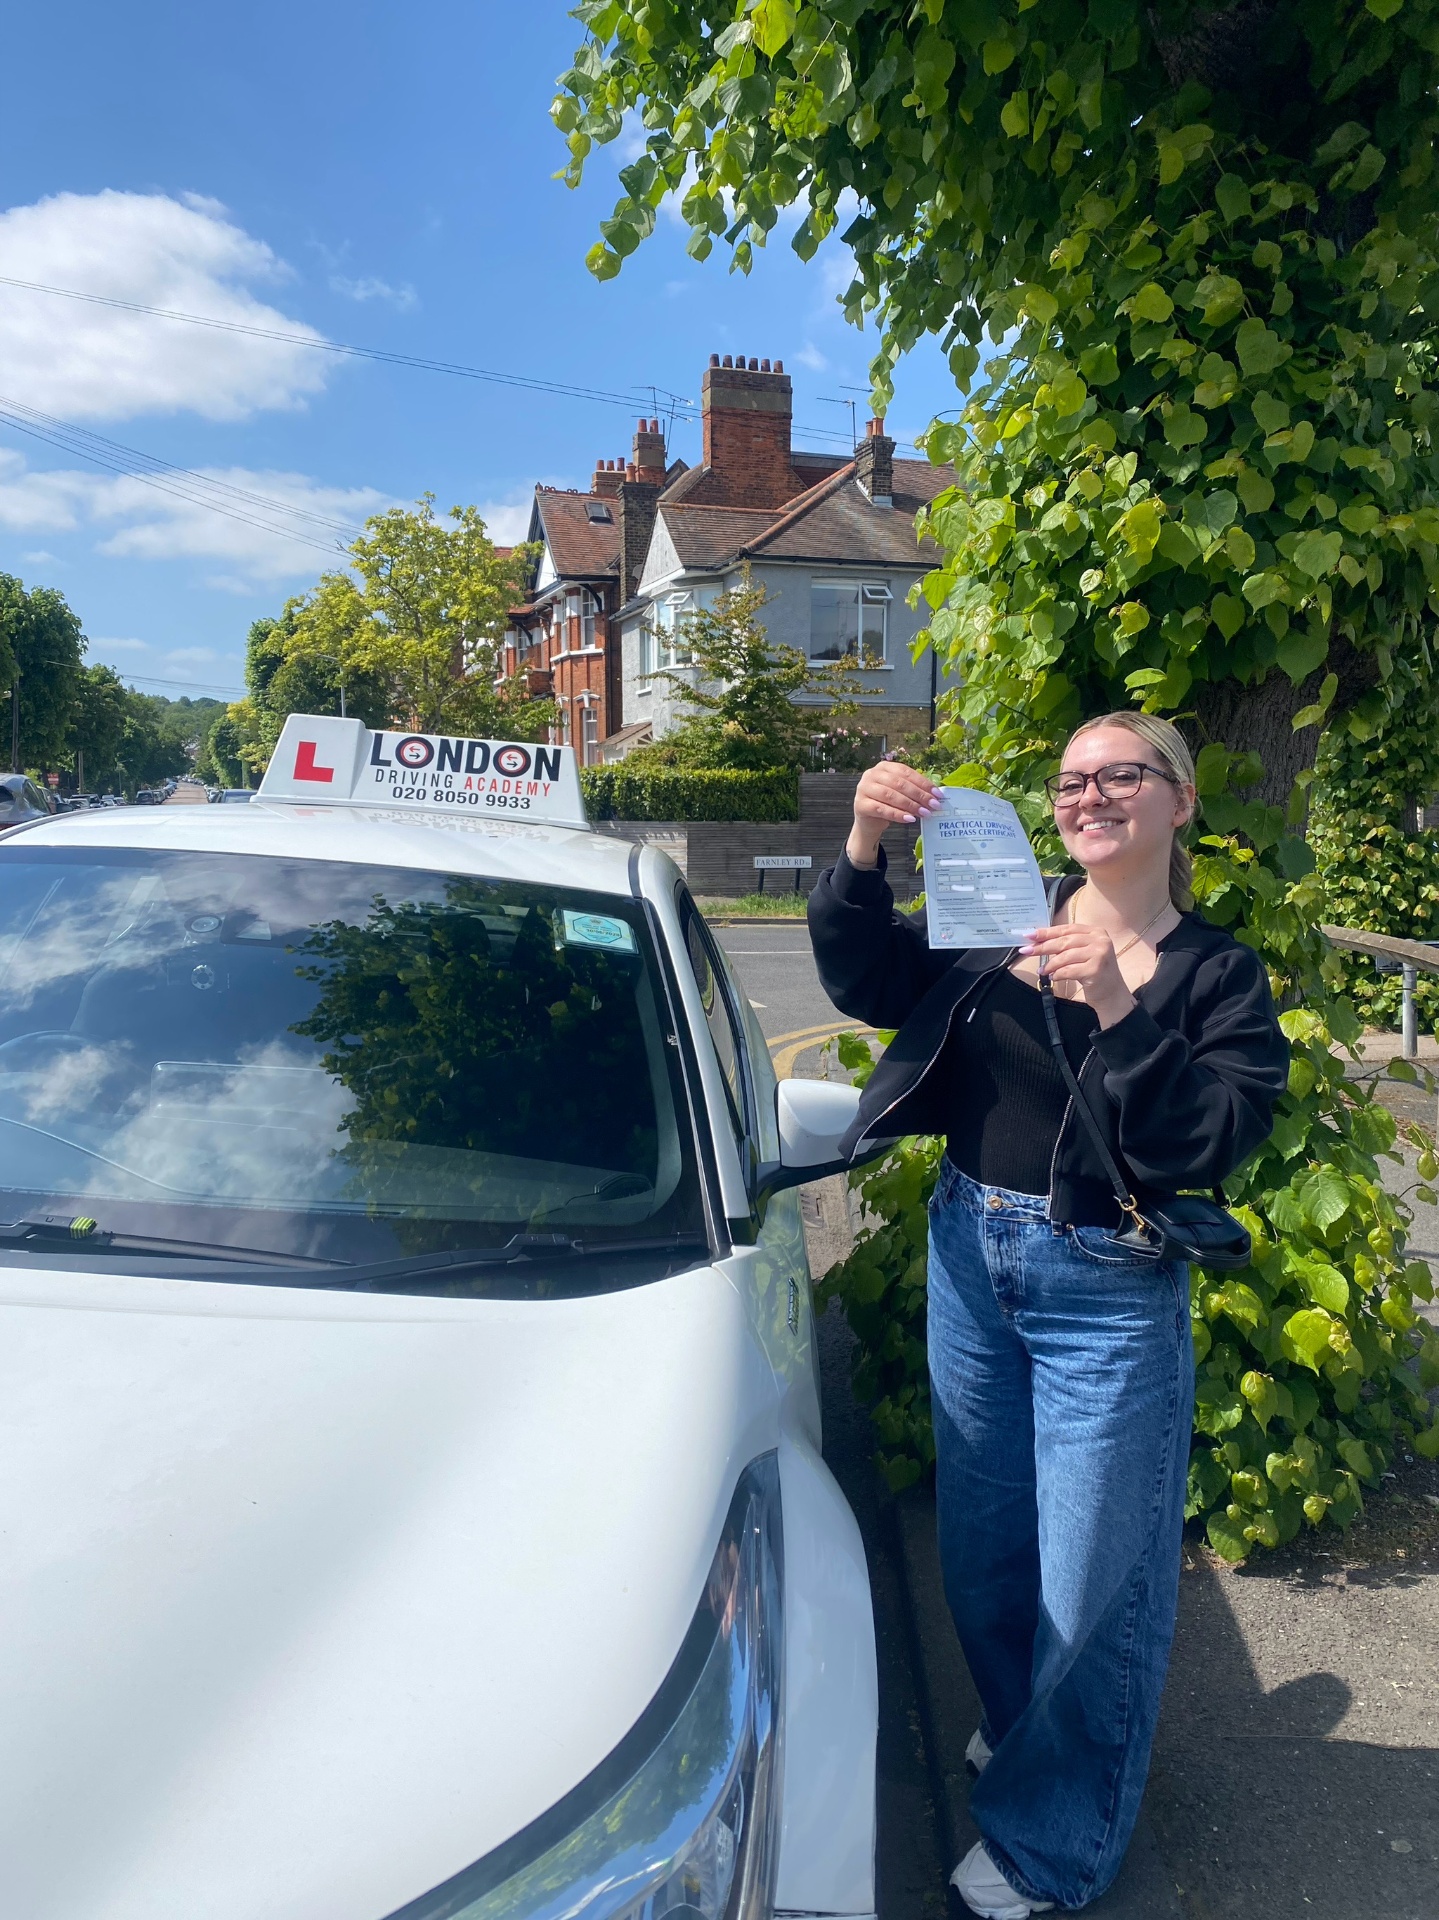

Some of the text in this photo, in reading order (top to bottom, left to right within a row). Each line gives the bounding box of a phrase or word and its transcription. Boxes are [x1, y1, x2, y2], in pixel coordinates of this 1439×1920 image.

[293, 741, 334, 783] L
[370, 733, 562, 782] LONDON
[375, 769, 551, 797] DRIVING ACADEMY
[392, 786, 531, 810] 020 8050 9933
[939, 820, 1015, 833] PRACTICAL DRIVING
[939, 829, 1016, 839] TEST PASS CERTIFICATE
[756, 858, 791, 866] FARNLEY
[794, 858, 805, 866] RD
